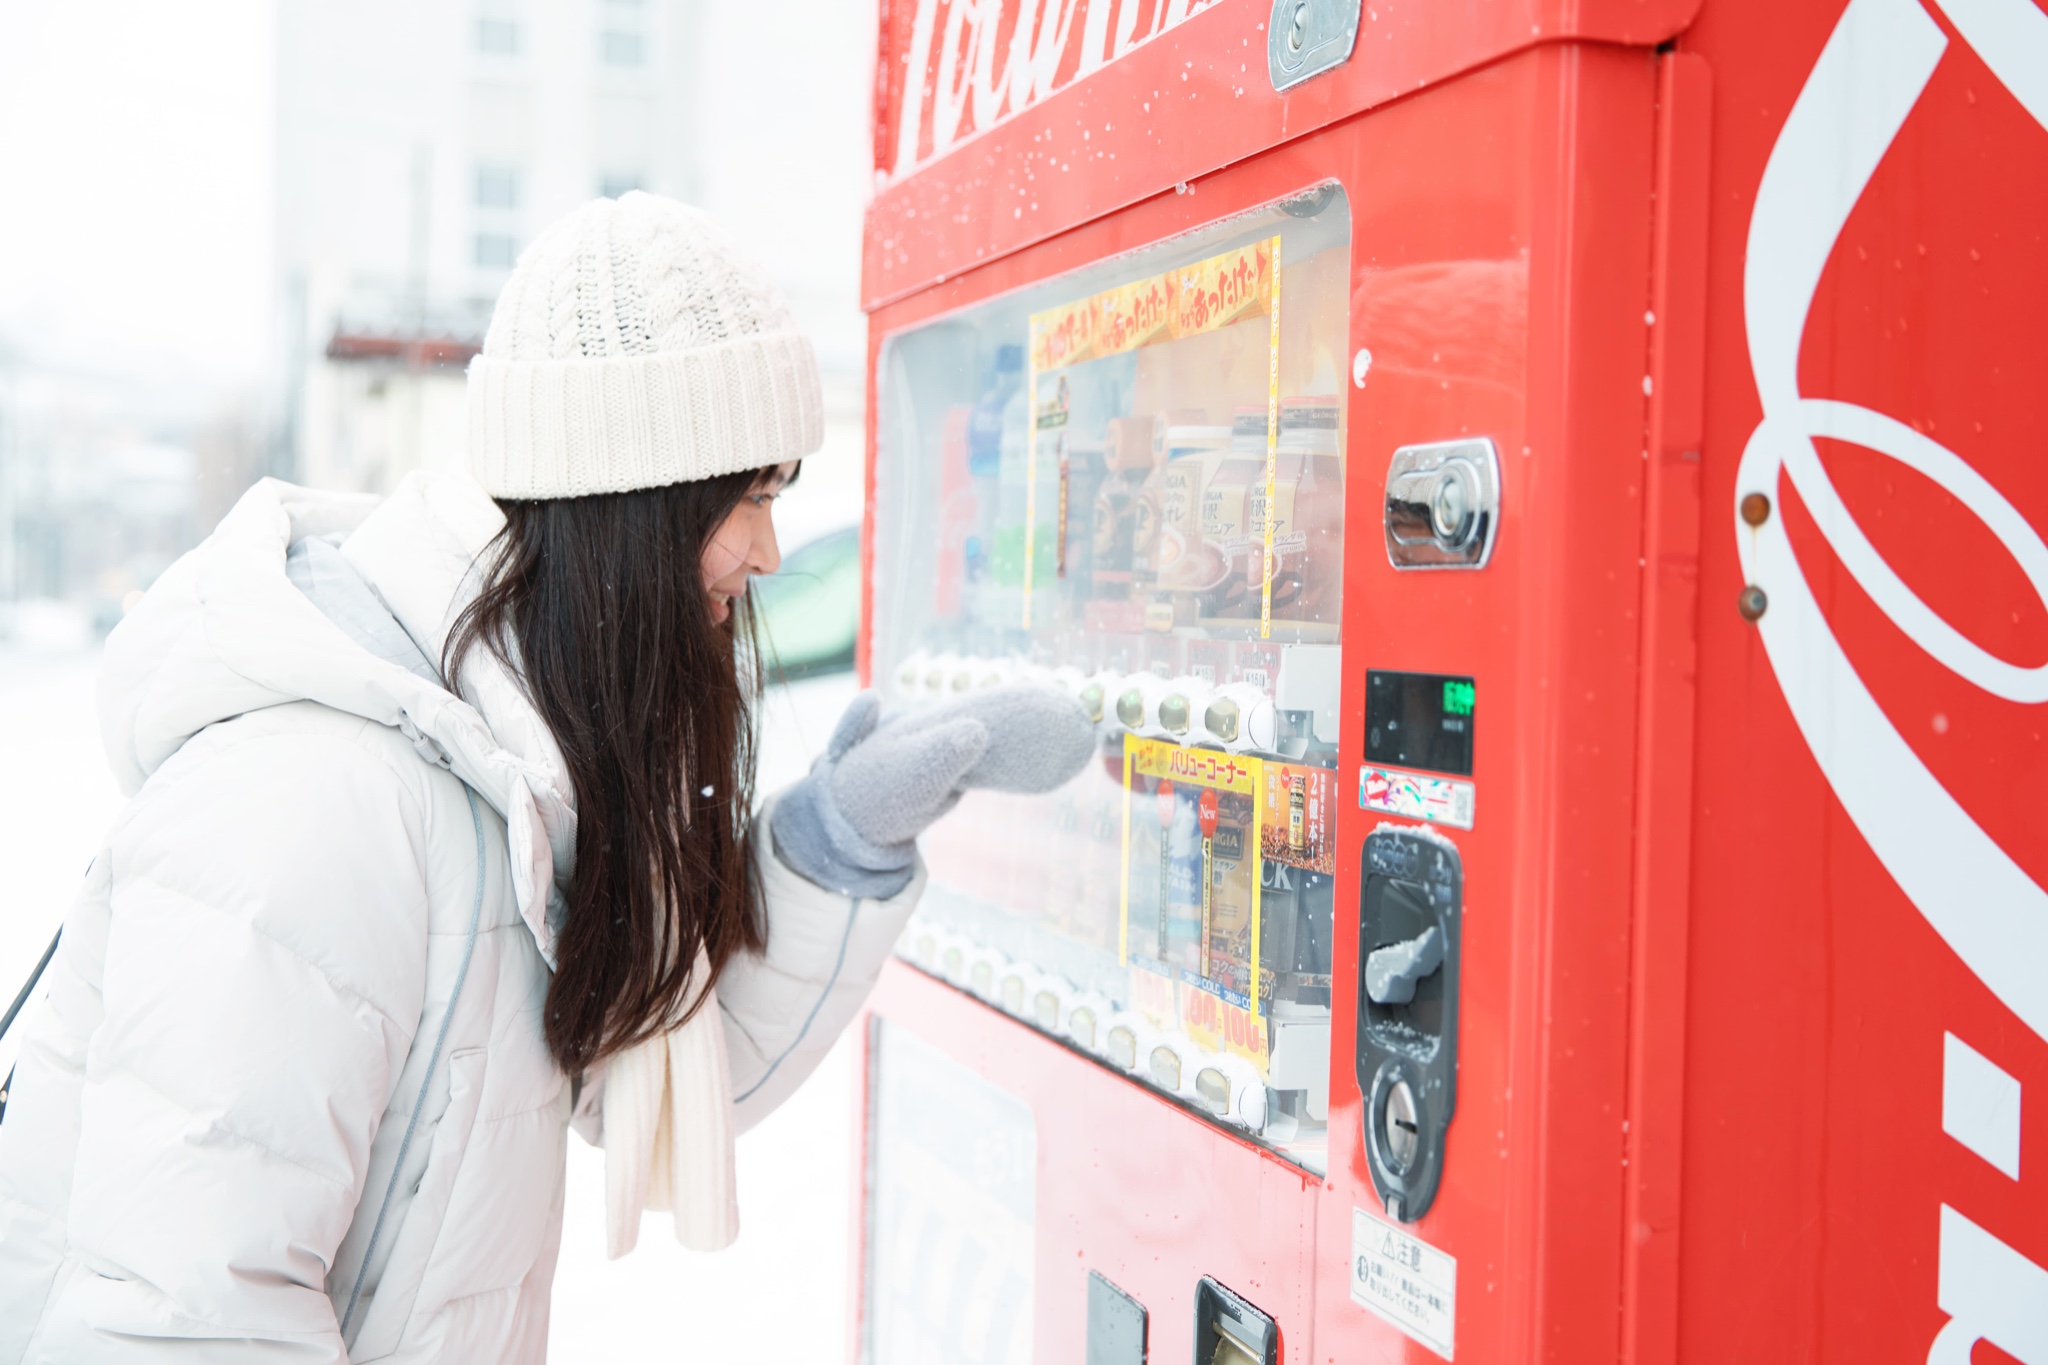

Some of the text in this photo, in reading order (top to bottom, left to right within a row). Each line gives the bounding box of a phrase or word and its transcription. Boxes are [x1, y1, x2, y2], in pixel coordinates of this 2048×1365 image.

[1268, 447, 1276, 485] HOT
[1266, 496, 1274, 536] HOT
[1264, 545, 1272, 583] HOT
[1262, 596, 1270, 636] HOT
[1169, 750, 1247, 785] バリューコーナー
[1200, 804, 1216, 820] New
[1202, 980, 1220, 995] COLD
[1242, 997, 1262, 1013] COD
[1397, 1237, 1421, 1273] 注意
